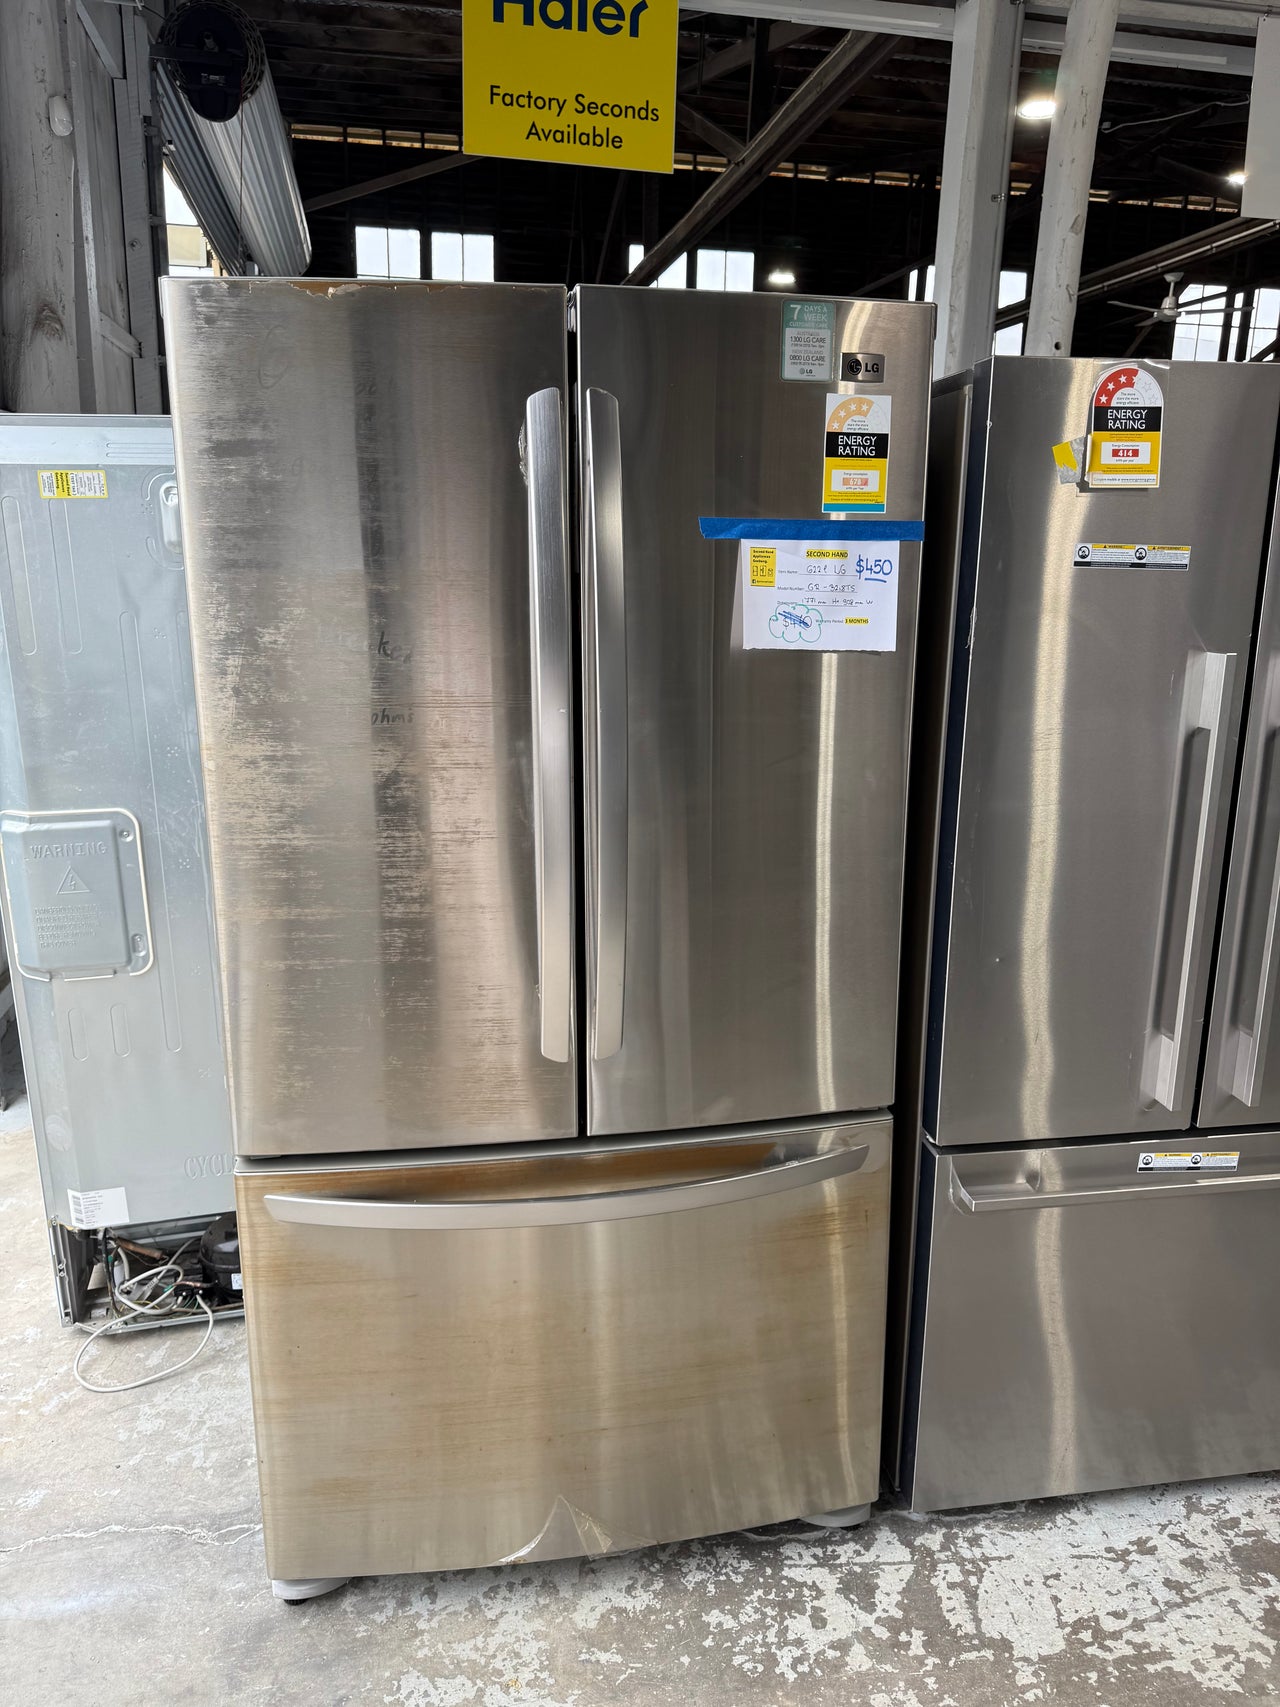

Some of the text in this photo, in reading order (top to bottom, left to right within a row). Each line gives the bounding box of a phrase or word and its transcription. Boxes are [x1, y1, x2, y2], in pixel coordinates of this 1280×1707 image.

[490, 85, 660, 122] Factory Seconds
[525, 121, 624, 150] Available
[790, 304, 802, 320] 7
[864, 362, 879, 373] LG
[1108, 409, 1147, 419] ENERGY
[1108, 420, 1146, 430] RATING
[838, 435, 877, 445] ENERGY
[838, 446, 876, 456] RATING
[834, 564, 846, 574] LG
[856, 554, 893, 580] $450
[30, 841, 108, 859] WARNING
[184, 1152, 234, 1180] CYCL
